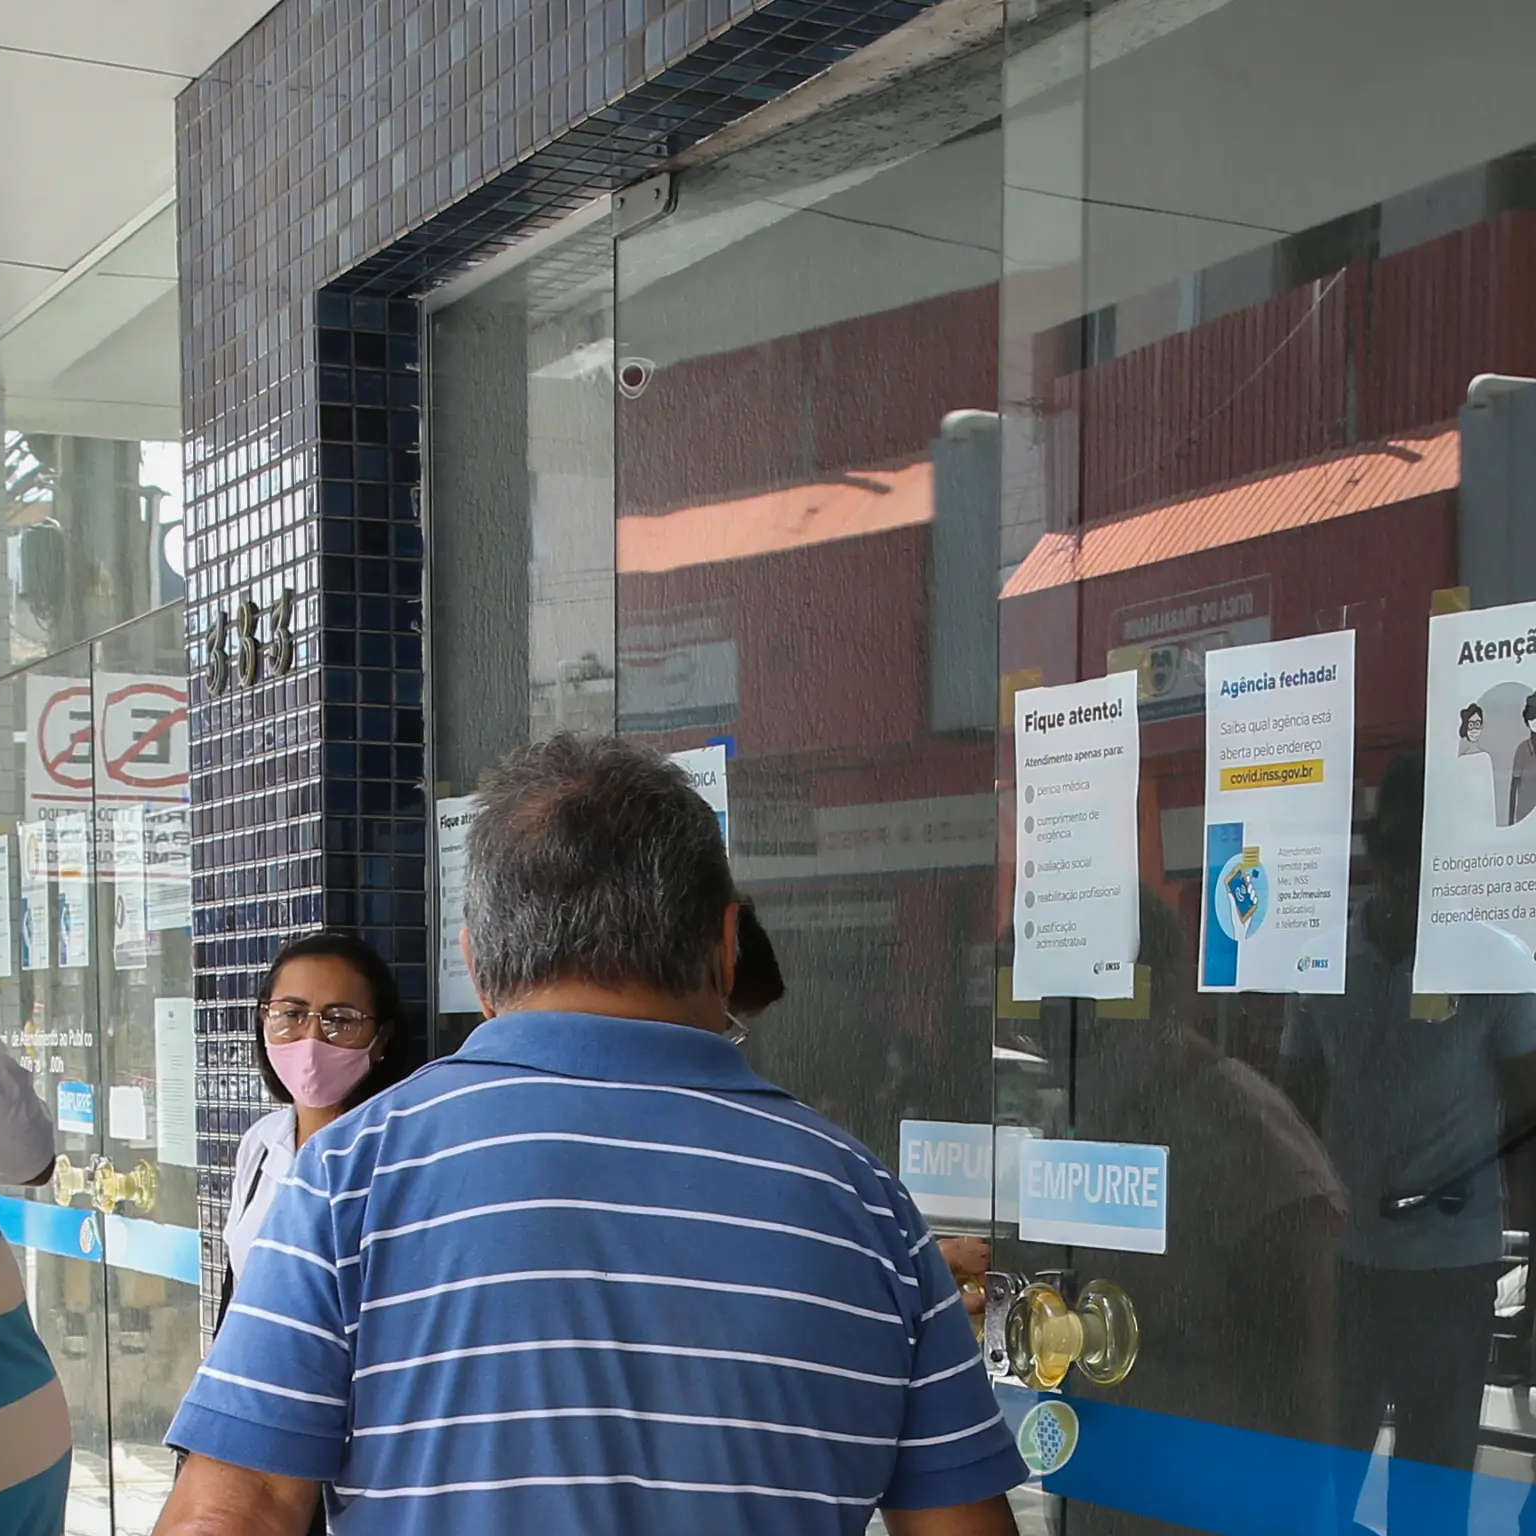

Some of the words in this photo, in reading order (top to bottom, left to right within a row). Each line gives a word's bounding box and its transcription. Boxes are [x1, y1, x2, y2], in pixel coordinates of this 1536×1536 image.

[1220, 672, 1276, 698] Agência
[1279, 664, 1337, 688] fechada!
[1024, 710, 1065, 735] Fique
[1069, 698, 1123, 726] atento!
[1220, 721, 1246, 736] Saiba
[1248, 715, 1270, 735] qual
[1272, 712, 1309, 732] agência
[1311, 709, 1332, 724] está
[1025, 753, 1072, 768] Atendimento
[1074, 749, 1102, 762] apenas
[1220, 747, 1252, 761] aberta
[1254, 743, 1275, 762] pelo
[1277, 738, 1322, 755] endereço
[1230, 764, 1313, 785] covid.inss.gov.br
[1432, 855, 1440, 872] É
[1442, 853, 1504, 873] obrigatório
[1506, 855, 1514, 866] o
[1516, 852, 1536, 865] uso
[1431, 883, 1485, 897] máscaras
[1486, 880, 1512, 897] para
[1309, 918, 1320, 928] 135
[1431, 906, 1510, 926] dependências
[1512, 904, 1527, 919] da
[1311, 959, 1329, 969] INSS
[906, 1139, 993, 1180] EMPU
[1027, 1160, 1160, 1208] EMPURRE
